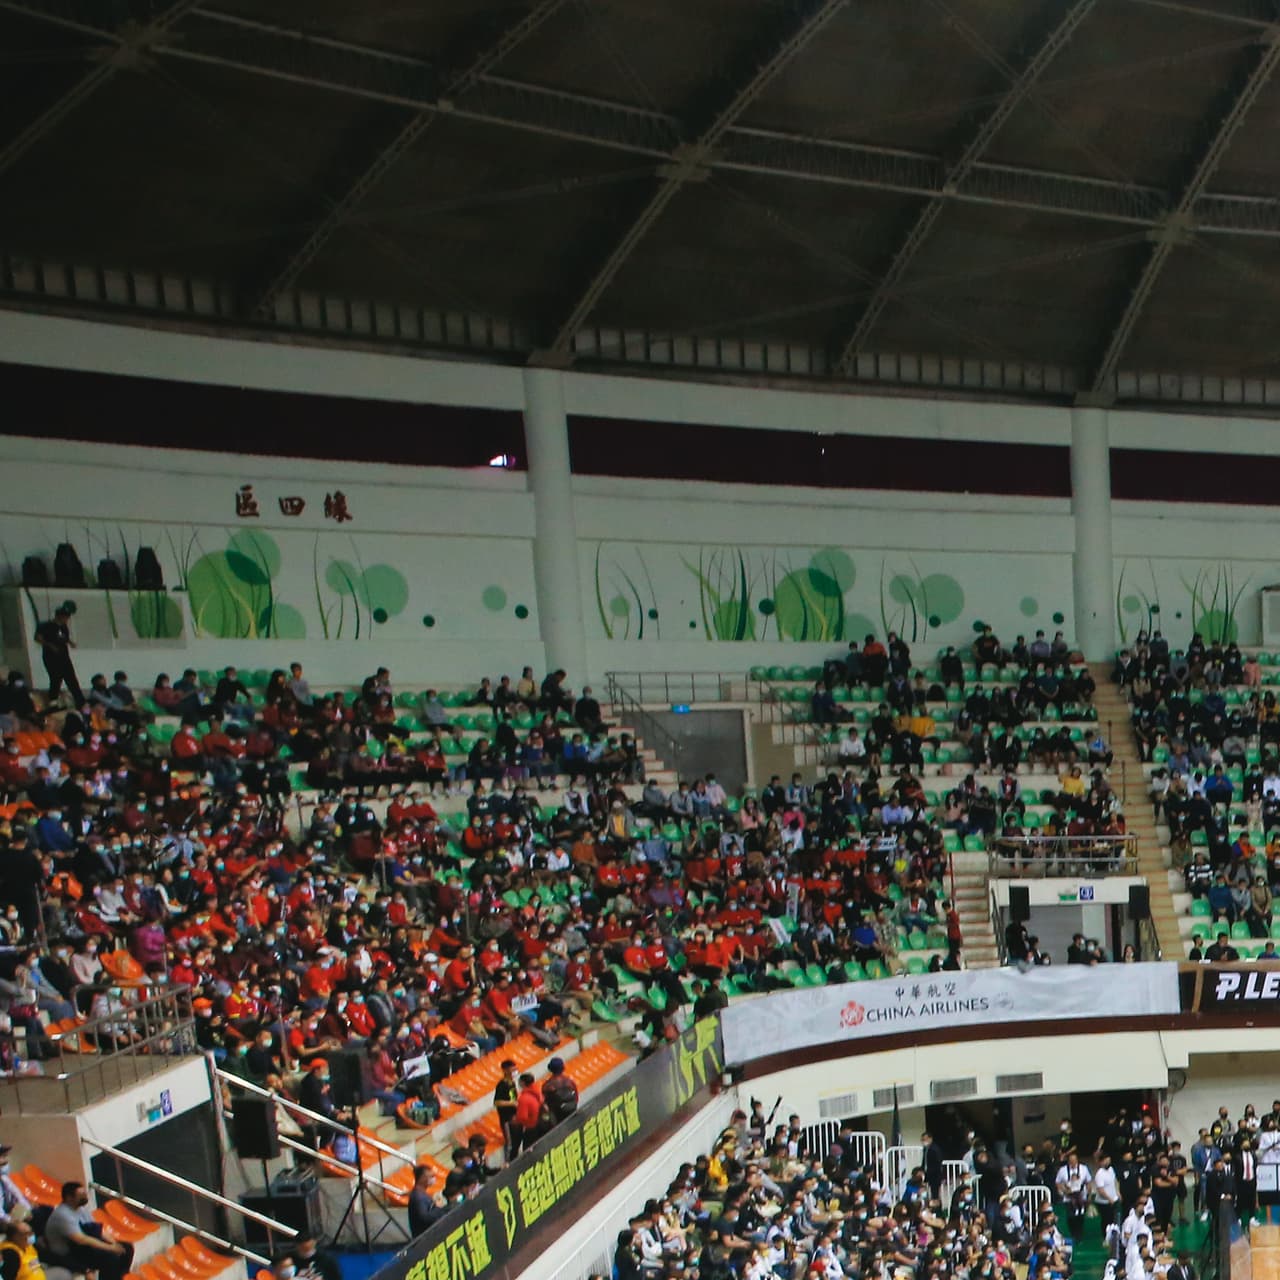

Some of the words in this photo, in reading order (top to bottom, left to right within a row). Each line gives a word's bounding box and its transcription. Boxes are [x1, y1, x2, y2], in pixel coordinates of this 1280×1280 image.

[894, 980, 958, 999] 中華航空
[866, 1003, 917, 1024] CHINA
[919, 996, 990, 1017] AIRLINES
[518, 1128, 585, 1228] 超越無限
